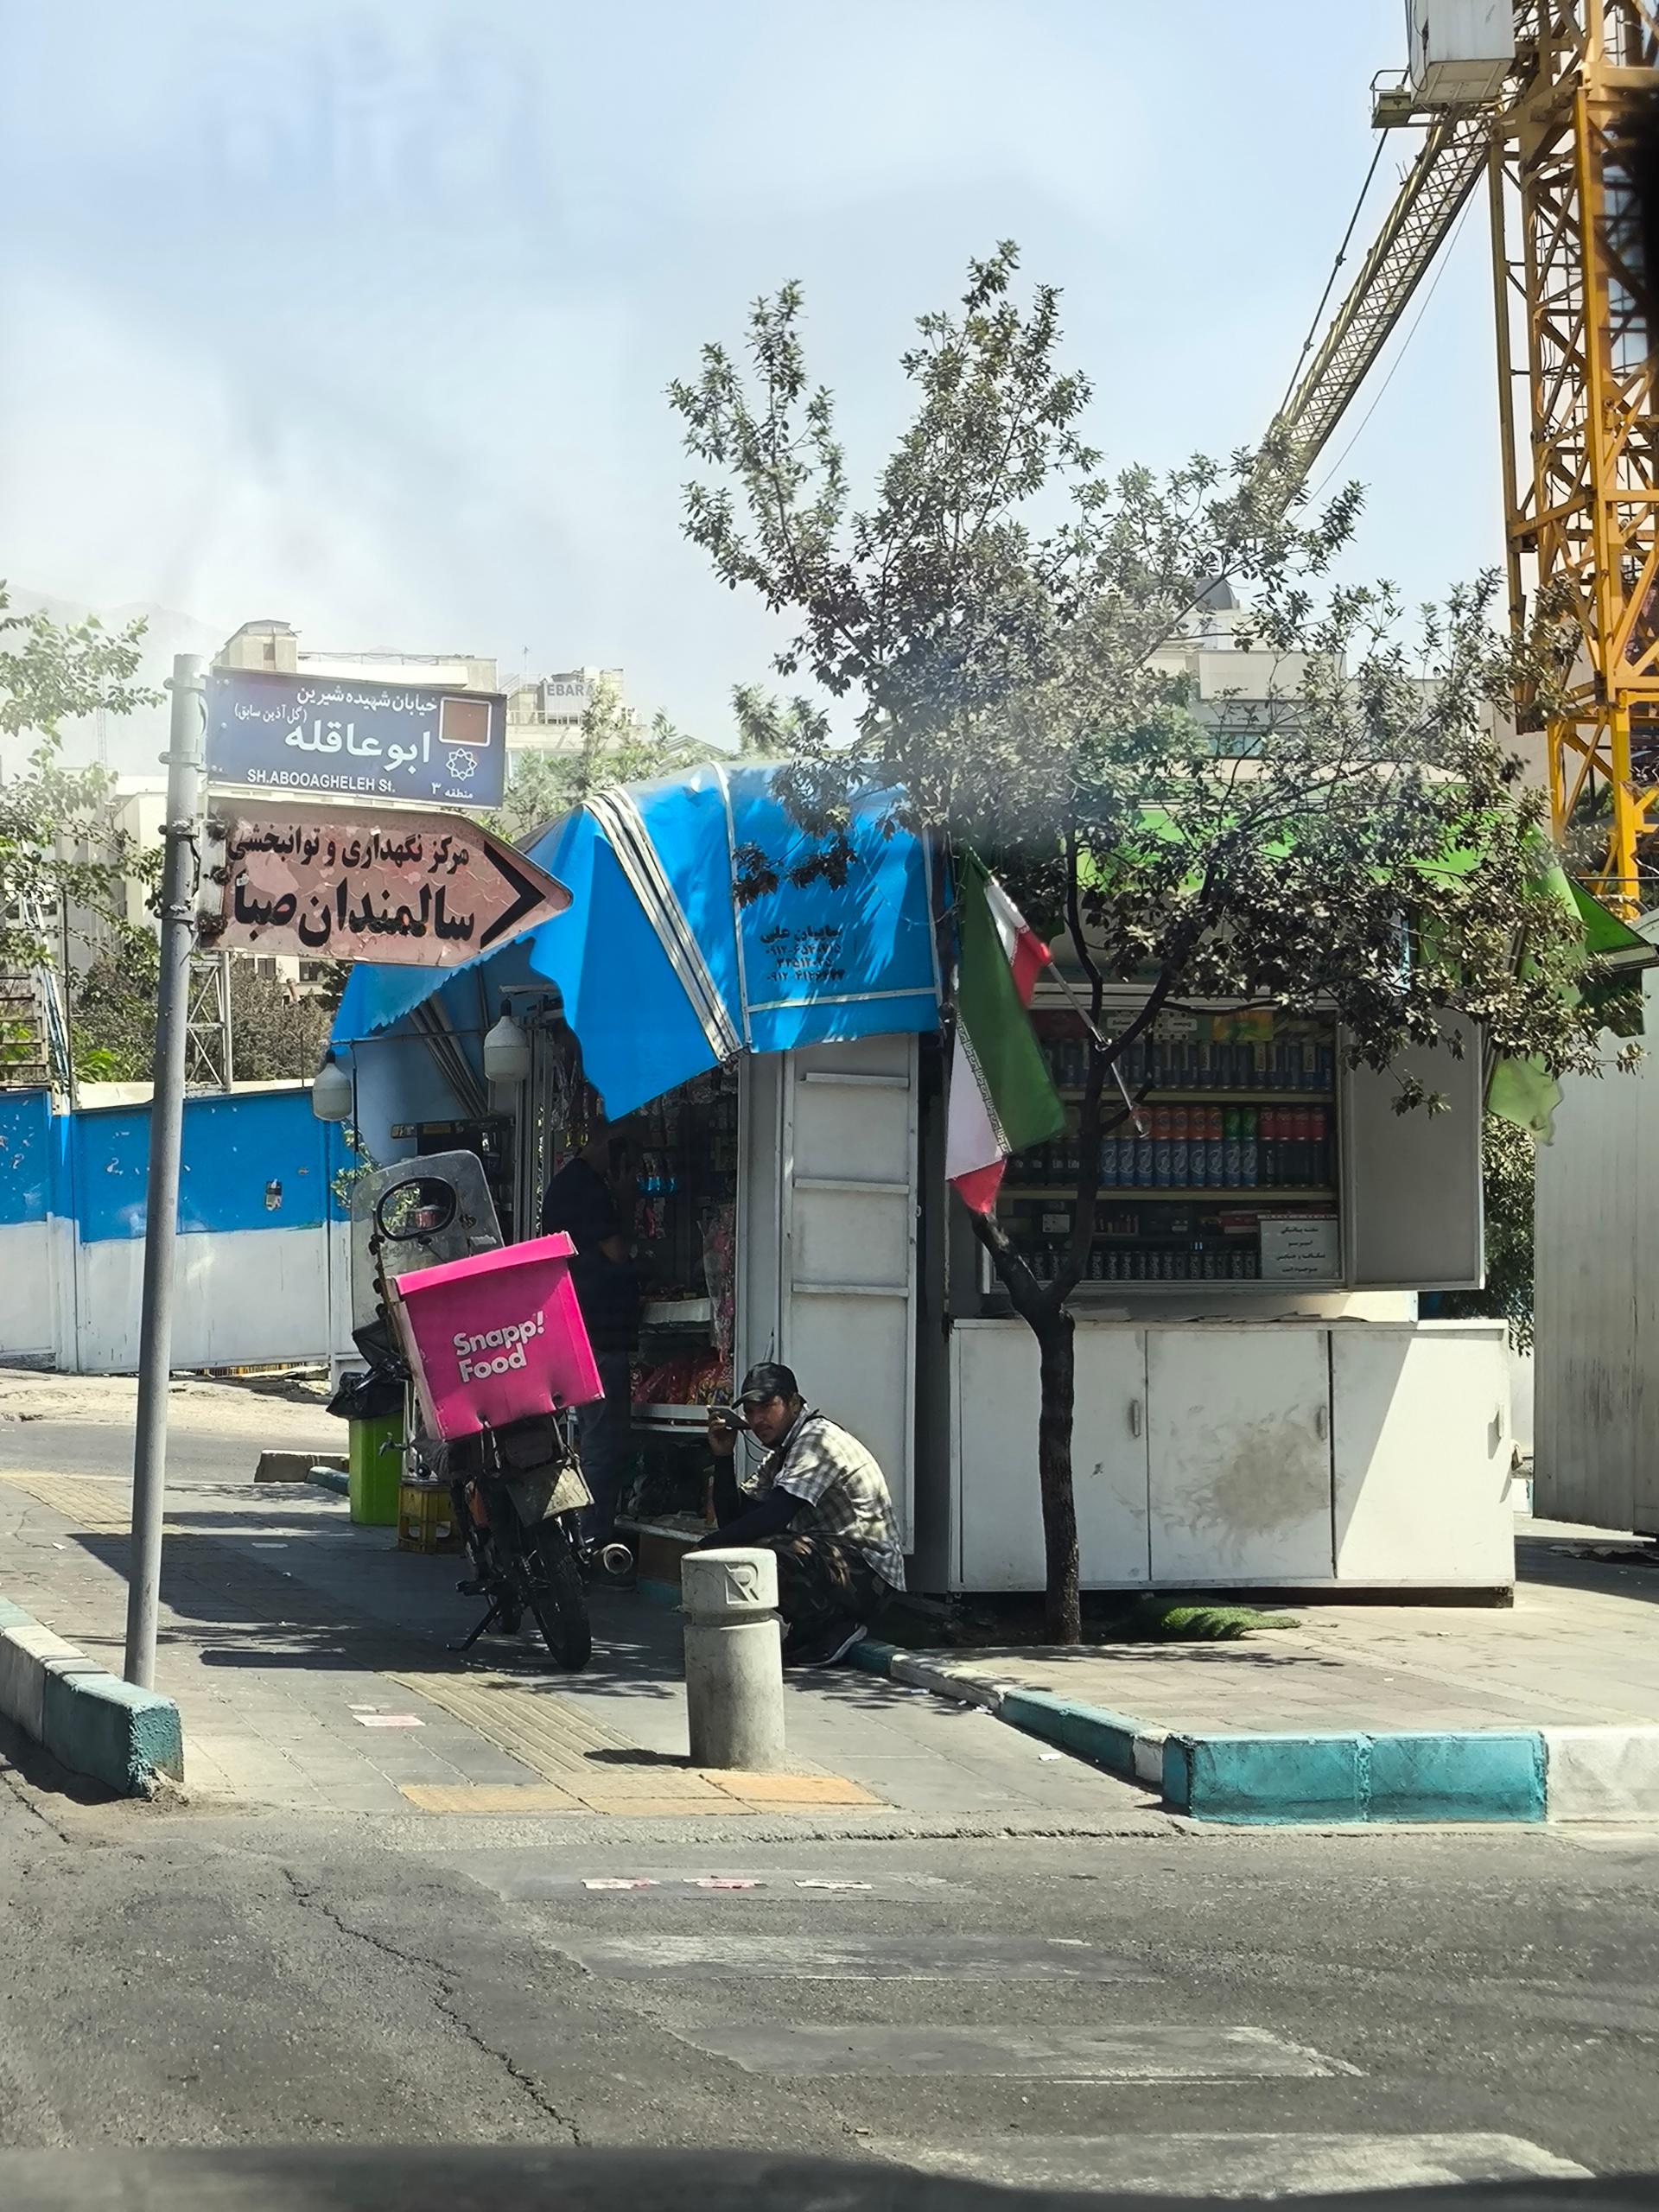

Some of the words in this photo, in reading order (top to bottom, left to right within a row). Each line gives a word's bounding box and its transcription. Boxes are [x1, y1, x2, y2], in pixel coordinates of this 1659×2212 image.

[296, 684, 345, 706] شیرین
[346, 690, 391, 712] شهیده
[392, 693, 437, 715] خیابان
[263, 703, 286, 723] آذین
[246, 768, 375, 791] SH.ABOOAGHELEH
[378, 779, 396, 793] St.
[431, 781, 442, 795] ۳
[444, 787, 474, 799] منطقه
[227, 823, 321, 866] توانبخشی
[326, 842, 337, 867] و
[341, 832, 423, 869] نگهداری
[428, 836, 470, 875] مرکز
[234, 867, 297, 942] صبا
[298, 877, 474, 947] سالمندان
[760, 925, 791, 944] علی
[453, 1310, 545, 1356] Snapp!
[458, 1342, 527, 1383] Food
